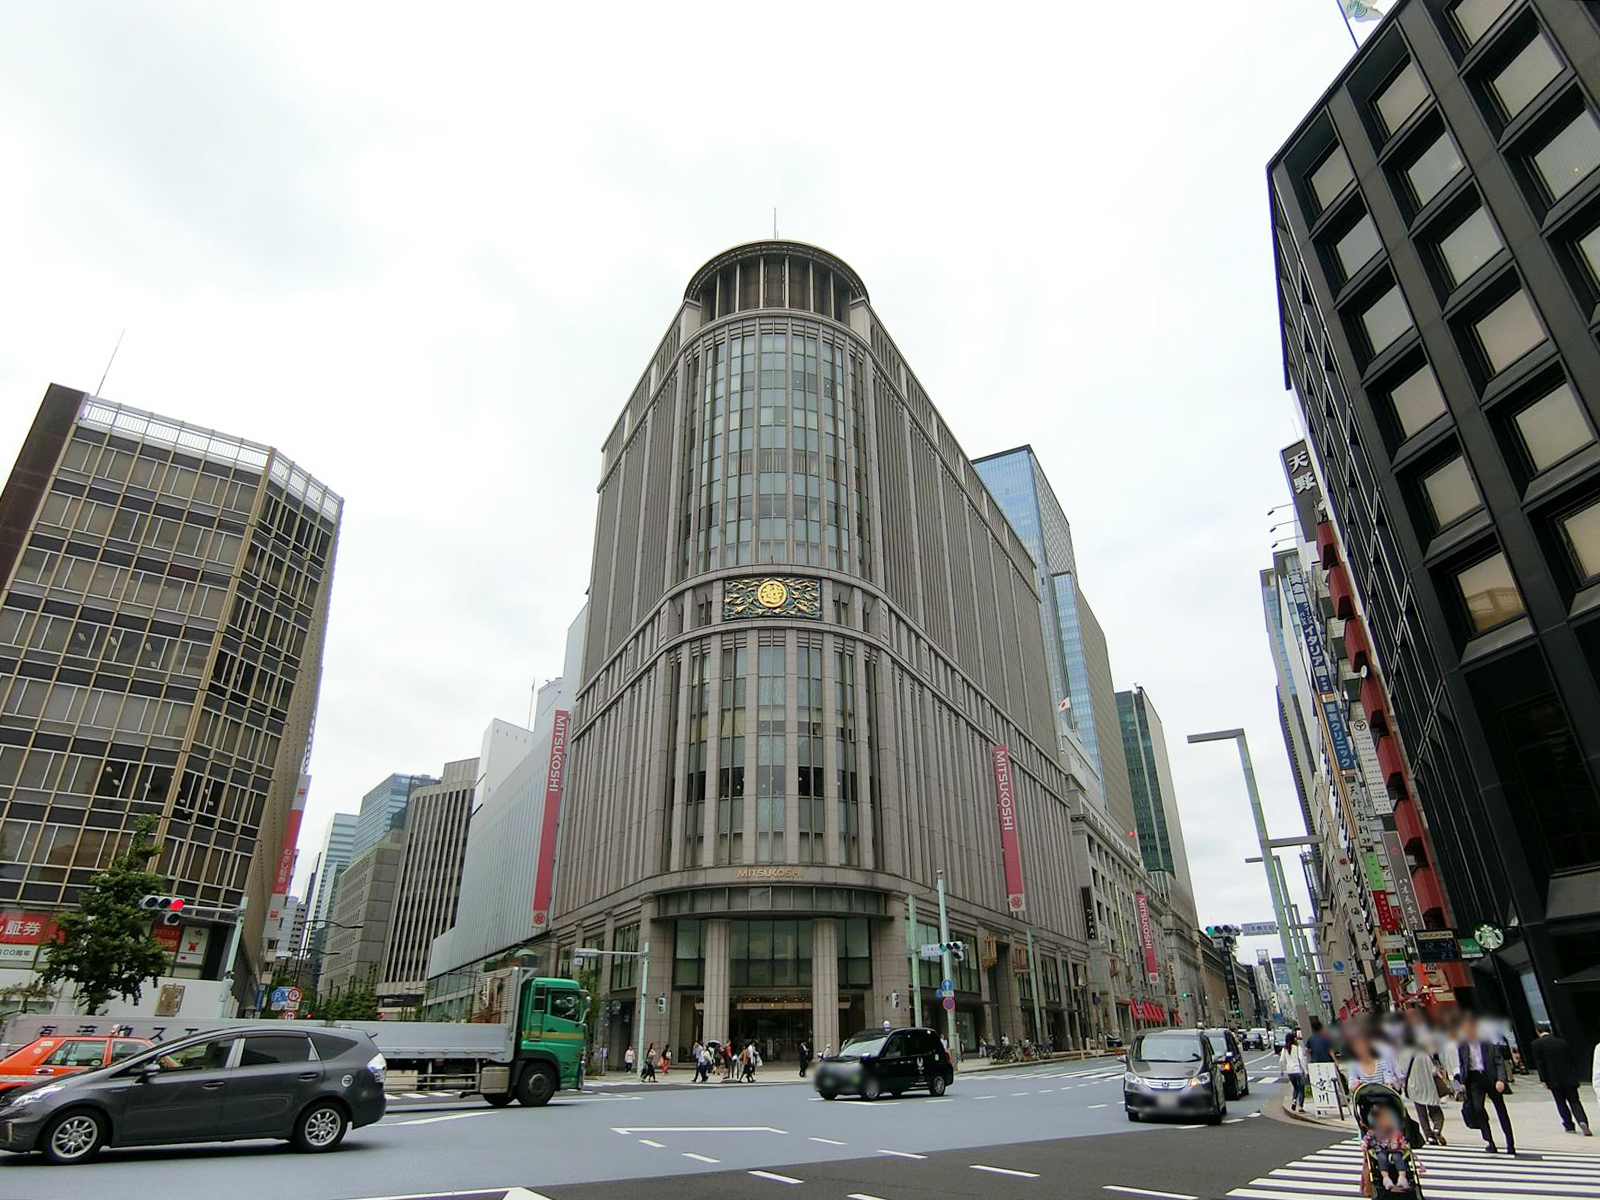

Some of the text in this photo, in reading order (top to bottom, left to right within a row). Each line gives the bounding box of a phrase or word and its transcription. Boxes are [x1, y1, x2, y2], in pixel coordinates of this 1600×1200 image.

[1287, 450, 1317, 494] 天野
[549, 715, 566, 792] MITSUKOSHI
[996, 750, 1014, 831] MITSUKOSHI
[737, 868, 803, 879] MITSUKOSHI
[0, 920, 42, 936] 証券
[1139, 897, 1153, 949] MITSUKOSHI
